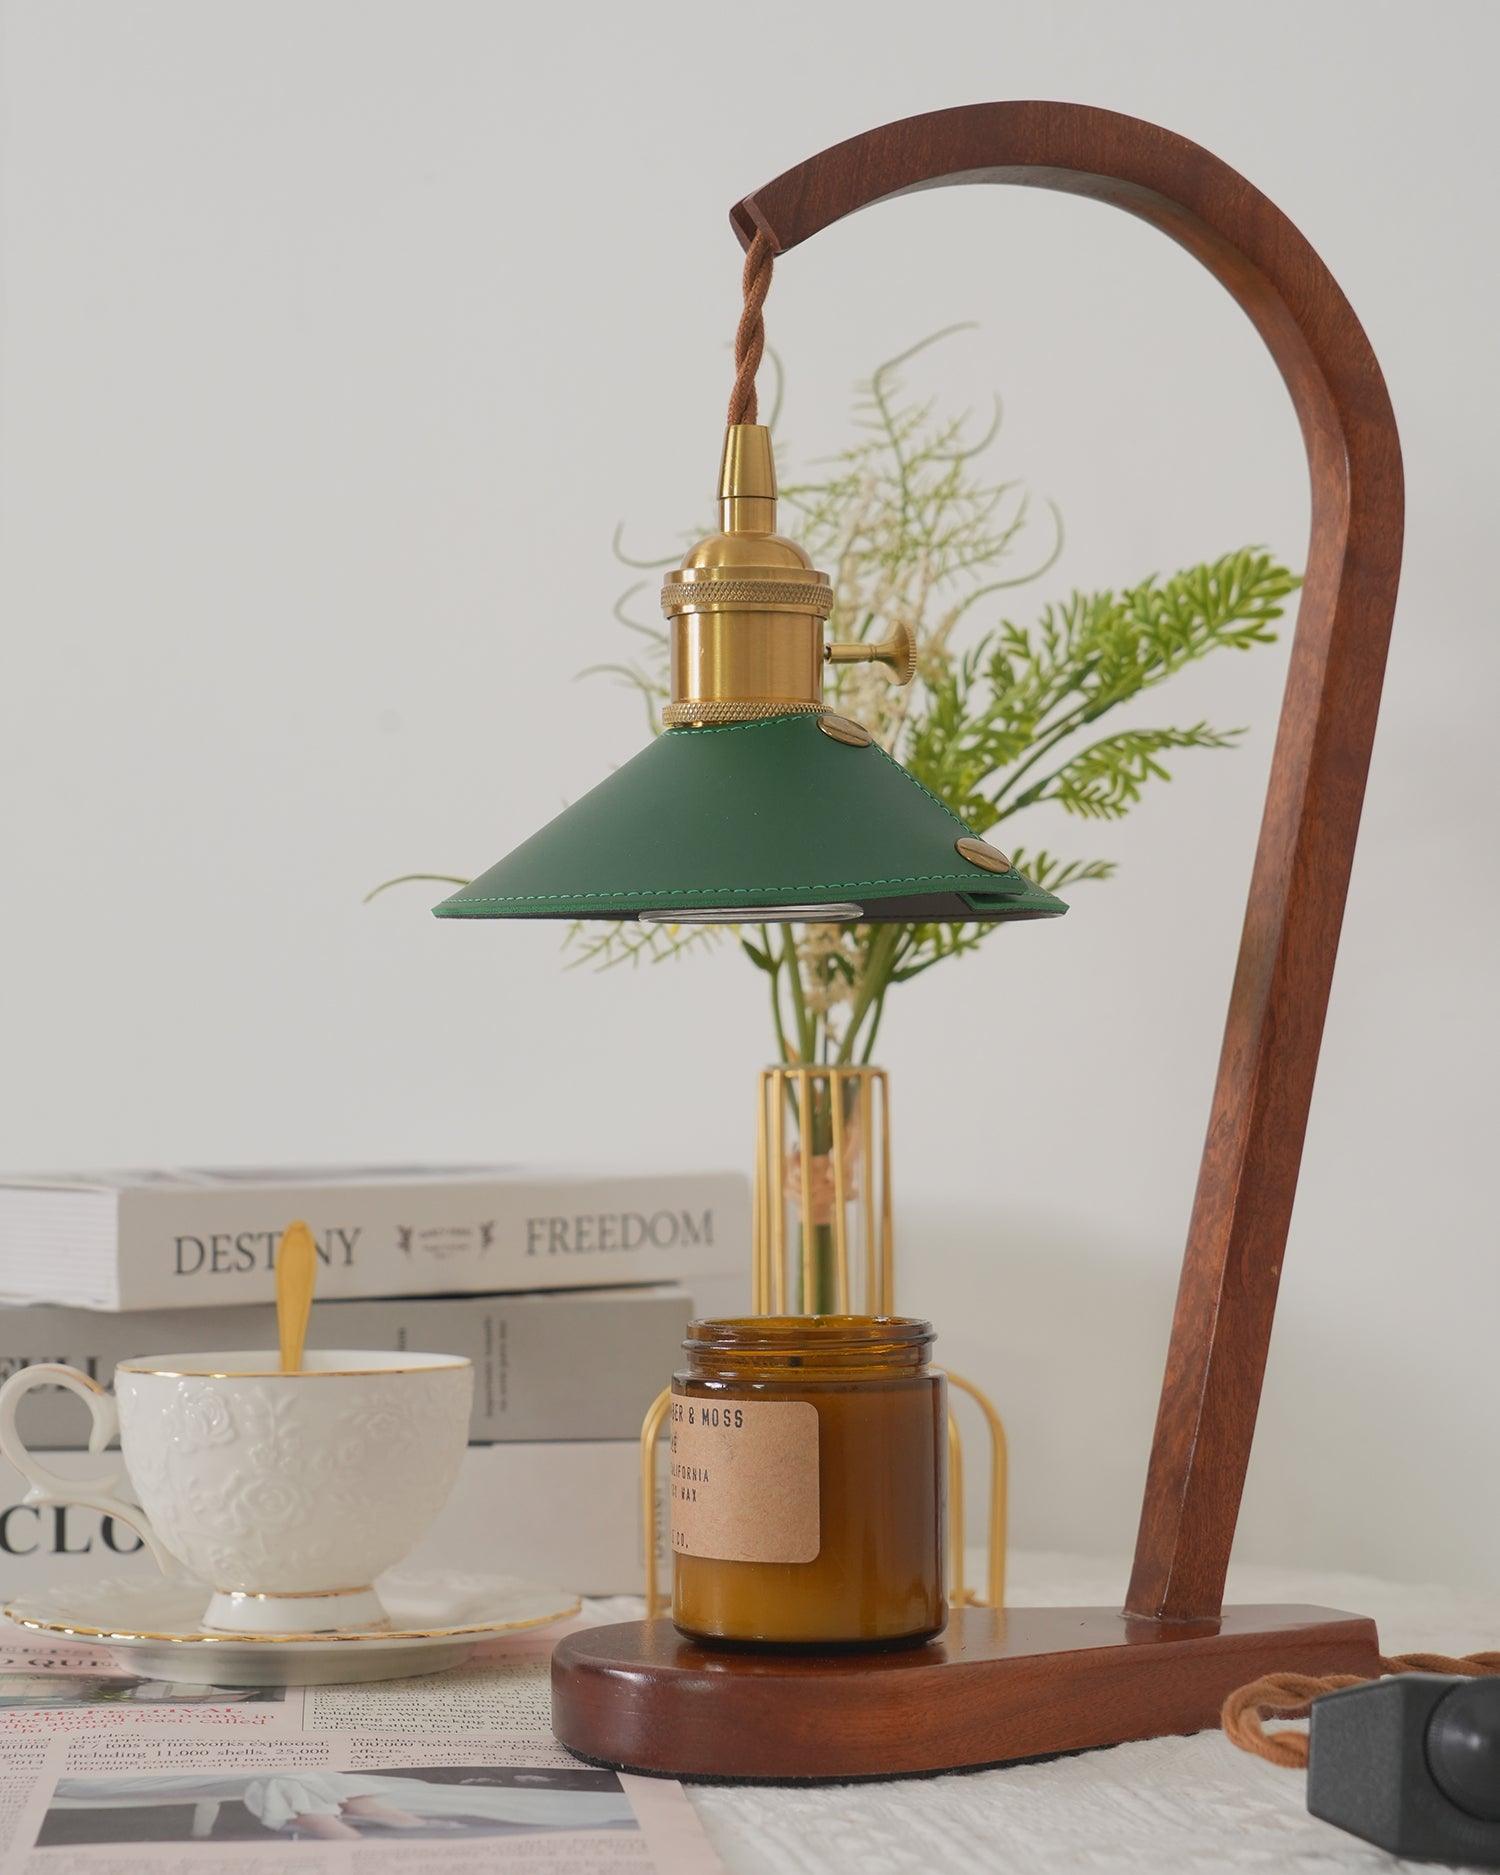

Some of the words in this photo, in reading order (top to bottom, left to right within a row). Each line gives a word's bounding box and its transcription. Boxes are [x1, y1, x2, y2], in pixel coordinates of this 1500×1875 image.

[173, 1226, 362, 1276] DESTNY
[524, 1208, 714, 1257] FREEDOM
[688, 1406, 695, 1424] &
[702, 1407, 743, 1428] MOSS
